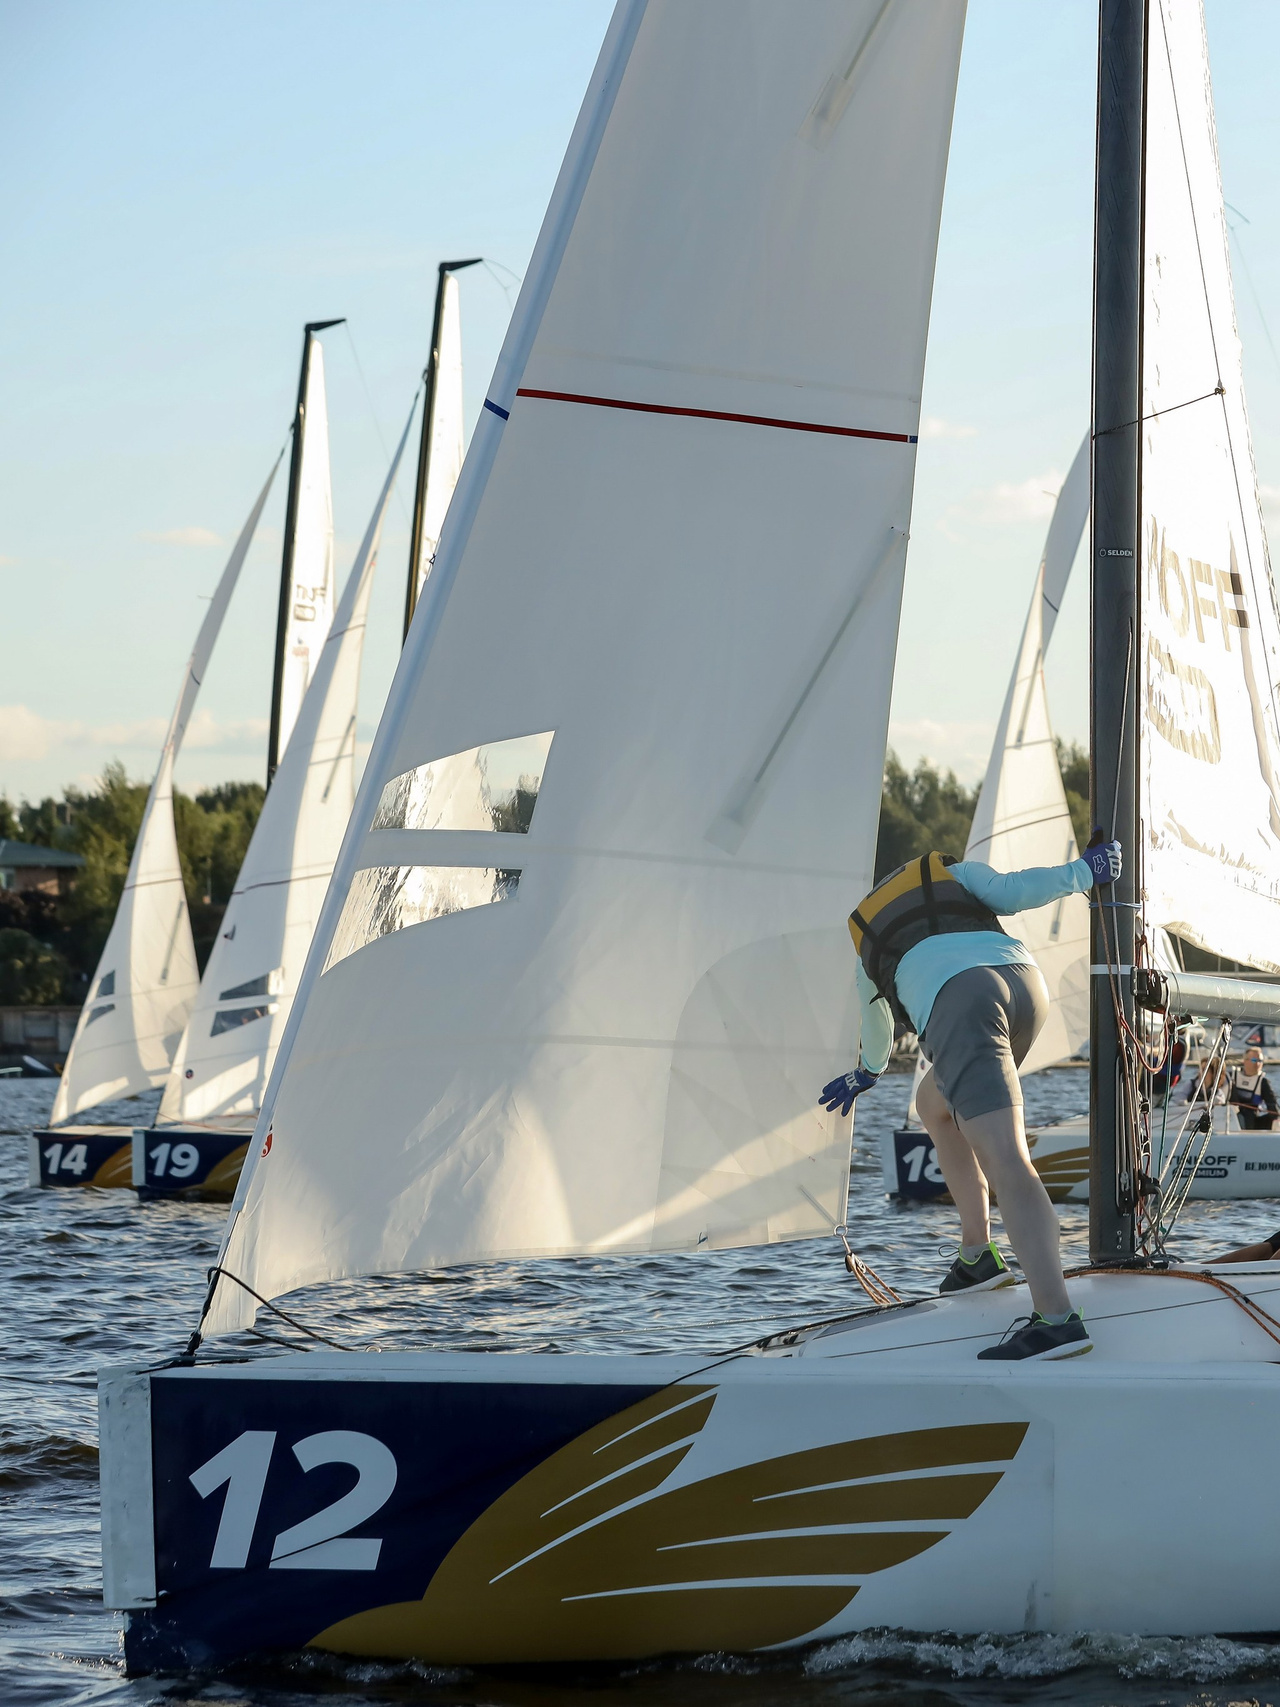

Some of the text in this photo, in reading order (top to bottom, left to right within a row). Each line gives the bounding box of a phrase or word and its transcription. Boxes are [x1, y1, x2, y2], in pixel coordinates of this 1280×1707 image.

[44, 1143, 88, 1175] 14
[149, 1143, 199, 1178] 19
[188, 1430, 398, 1571] 12
